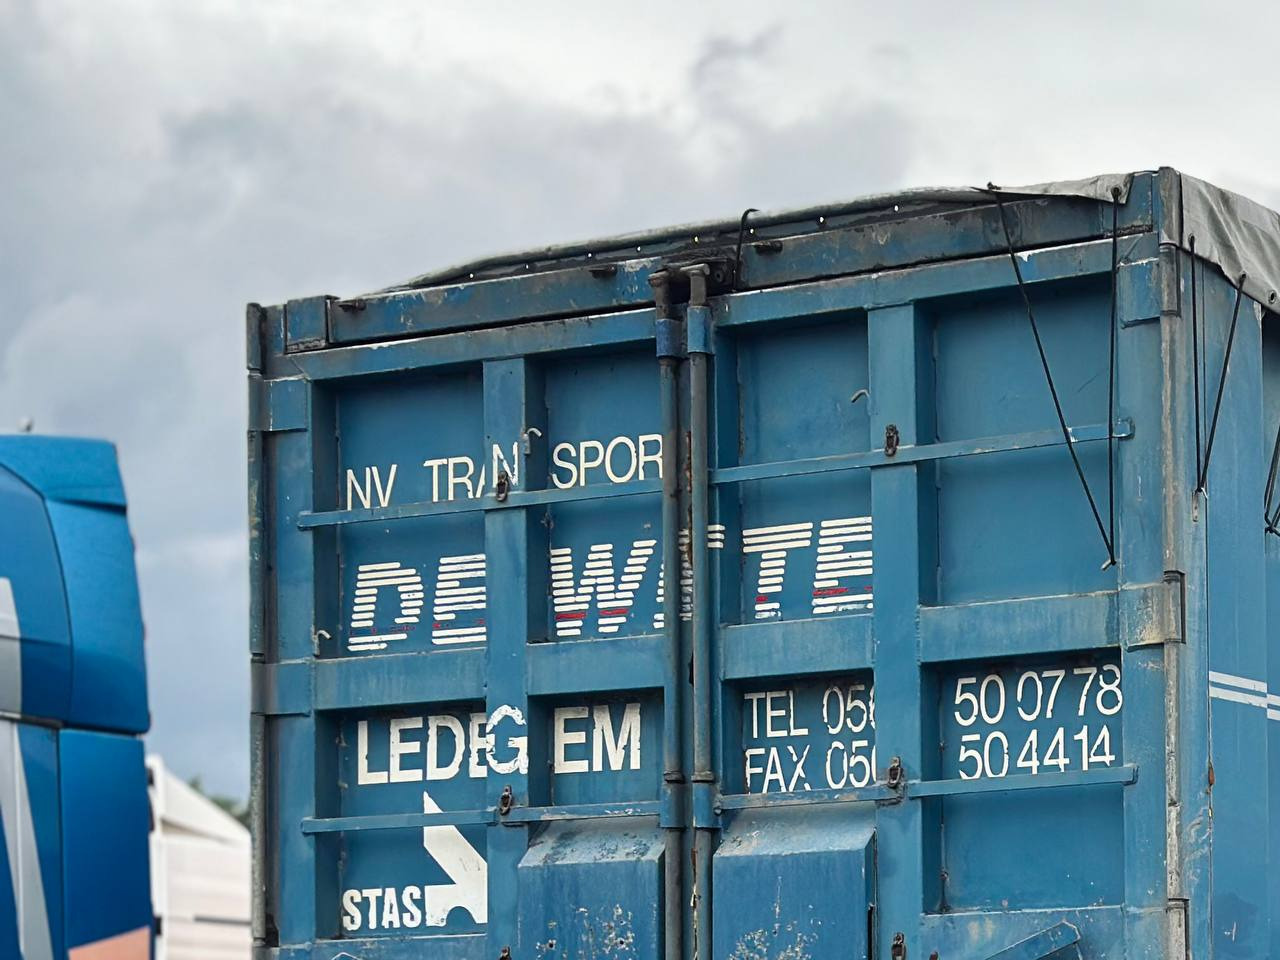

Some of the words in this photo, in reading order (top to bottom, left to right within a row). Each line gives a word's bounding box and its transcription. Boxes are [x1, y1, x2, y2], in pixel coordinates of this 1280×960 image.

[347, 464, 398, 511] NV
[744, 690, 809, 739] TEL
[954, 674, 1006, 727] 50
[745, 744, 812, 796] FAX
[825, 740, 877, 790] 05
[342, 885, 422, 931] STAS
